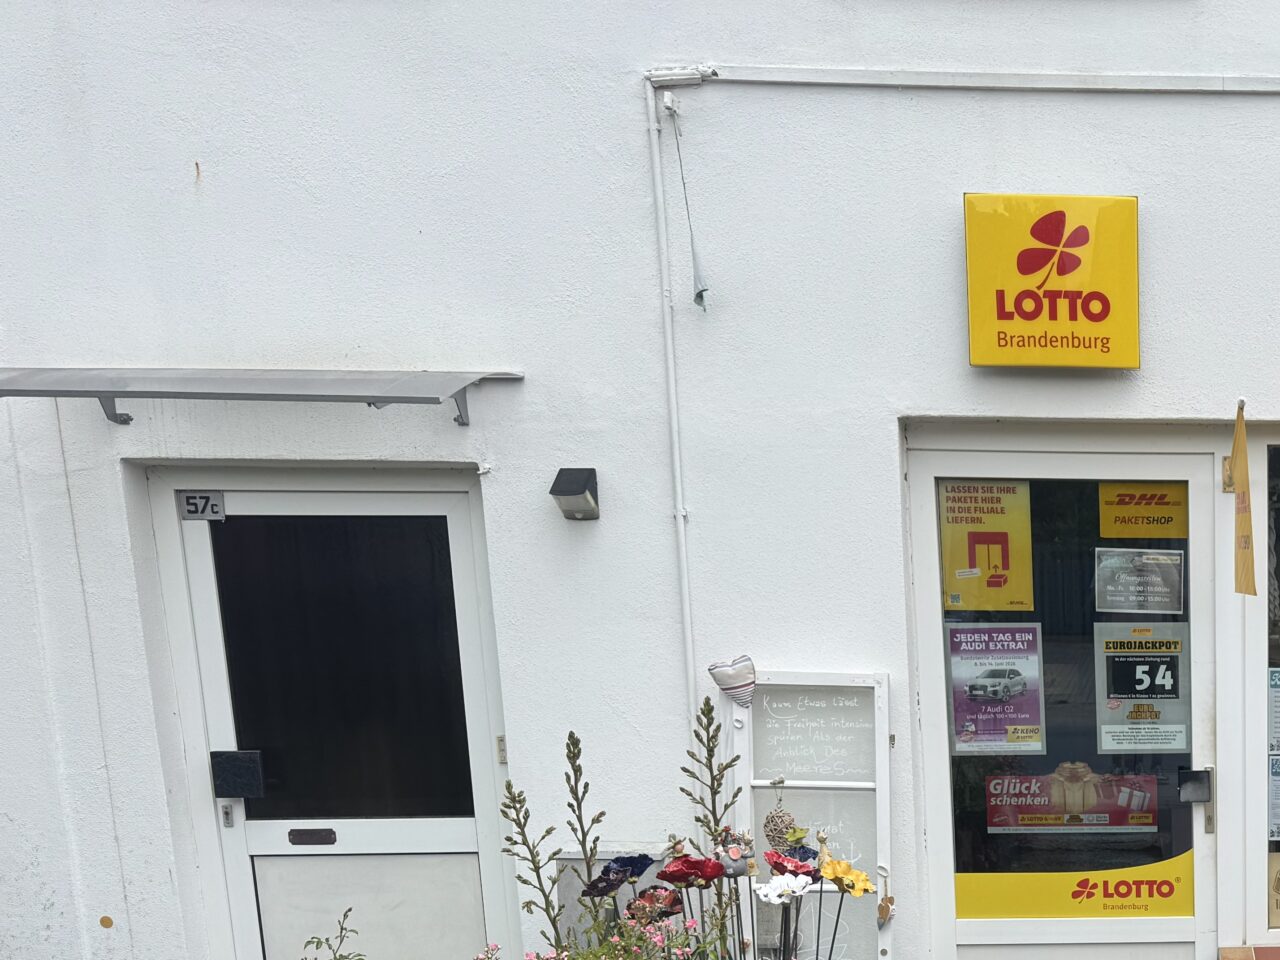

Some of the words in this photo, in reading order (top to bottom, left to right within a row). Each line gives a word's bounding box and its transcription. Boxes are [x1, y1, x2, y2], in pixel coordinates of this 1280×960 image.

[996, 290, 1111, 322] LOTTO
[997, 331, 1111, 353] Brandenburg
[946, 485, 979, 494] LASSEN
[981, 486, 995, 494] SIE
[997, 486, 1017, 494] IHRE
[946, 496, 979, 504] PAKETE
[981, 496, 1002, 504] HIER
[1115, 493, 1172, 506] DHL
[947, 506, 956, 514] IN
[958, 506, 972, 514] DIE
[974, 506, 1006, 514] FILIALE
[947, 516, 985, 525] LIEFERN.
[1114, 516, 1174, 525] PAKETSHOP
[954, 633, 988, 642] JEDEN
[992, 633, 1012, 641] TAG
[1015, 633, 1033, 641] EIN
[960, 642, 986, 650] AUDI
[989, 641, 1027, 650] EXTRA!
[1105, 641, 1180, 650] EUROJACKPOT
[1135, 664, 1174, 691] 54
[989, 779, 1041, 795] Glück
[990, 794, 1049, 806] schenken
[1102, 880, 1175, 899] LOTTO
[1102, 903, 1149, 911] Brandenburg
